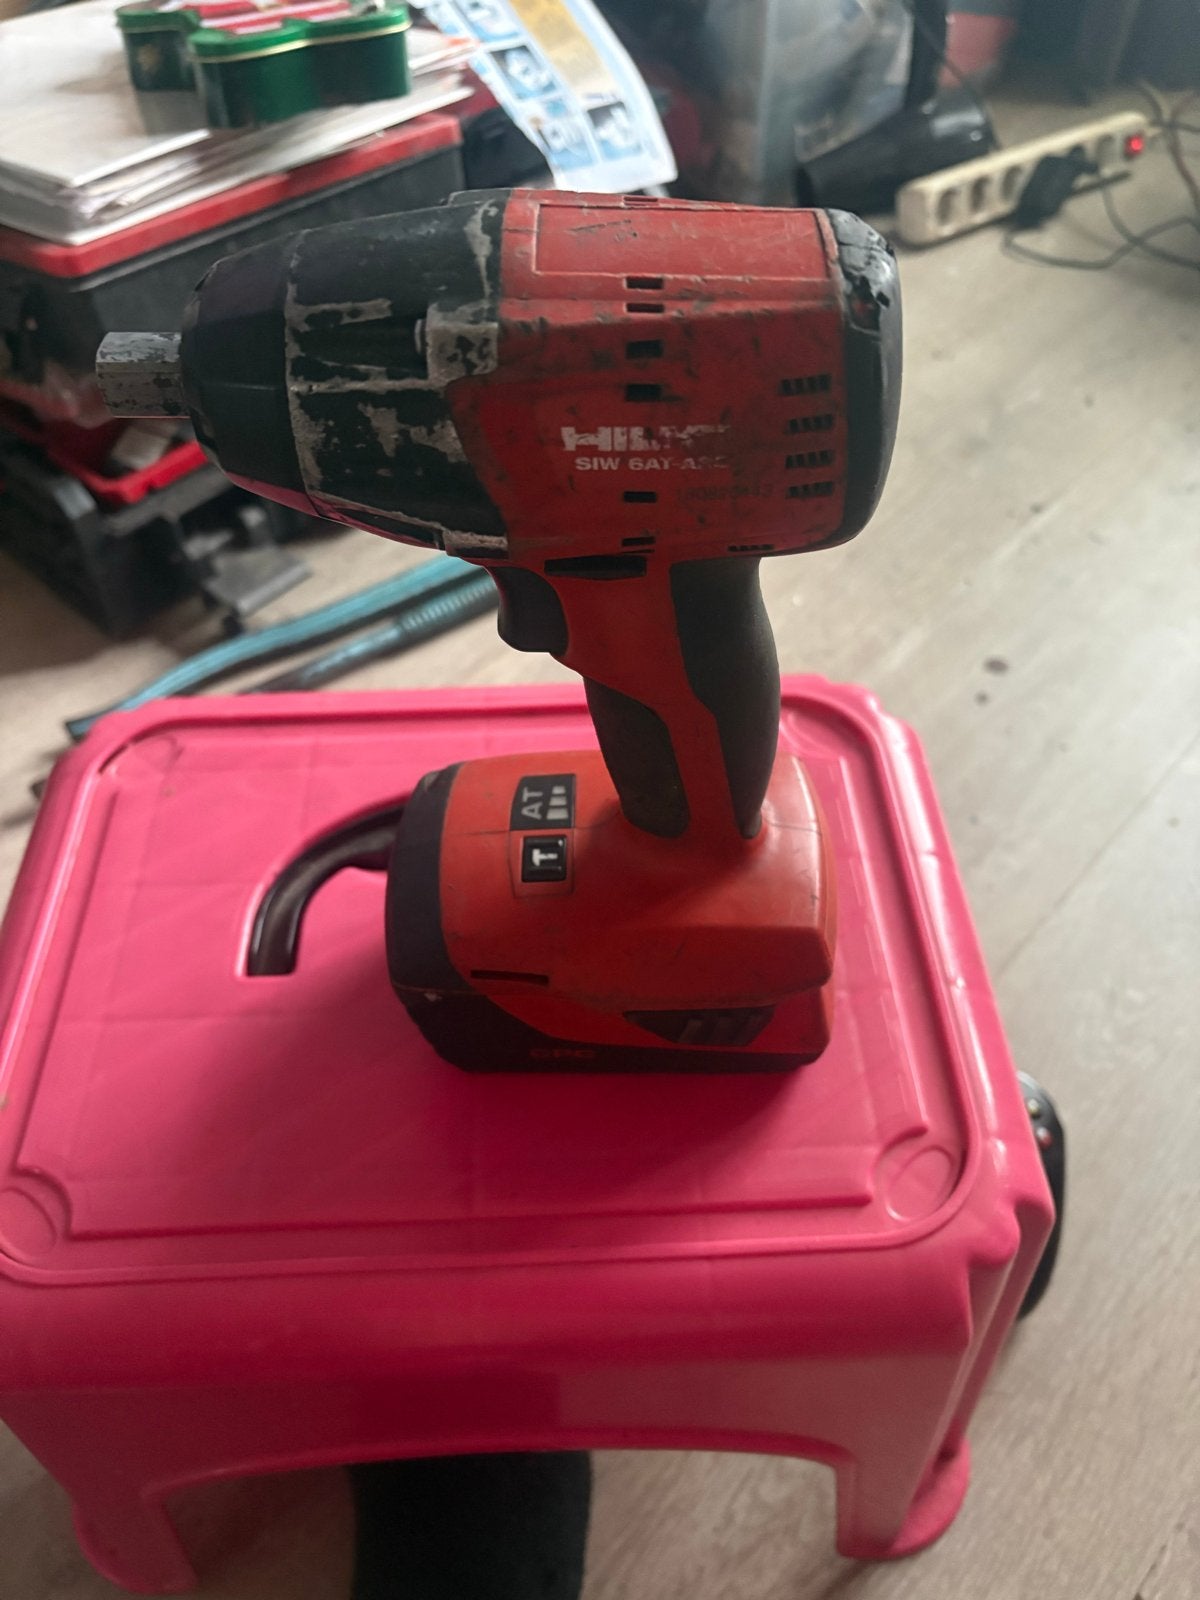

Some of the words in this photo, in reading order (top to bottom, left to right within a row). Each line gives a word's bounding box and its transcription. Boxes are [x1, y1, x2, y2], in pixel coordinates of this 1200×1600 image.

[561, 425, 731, 451] HIL
[575, 457, 620, 470] SIW
[521, 787, 543, 820] AT
